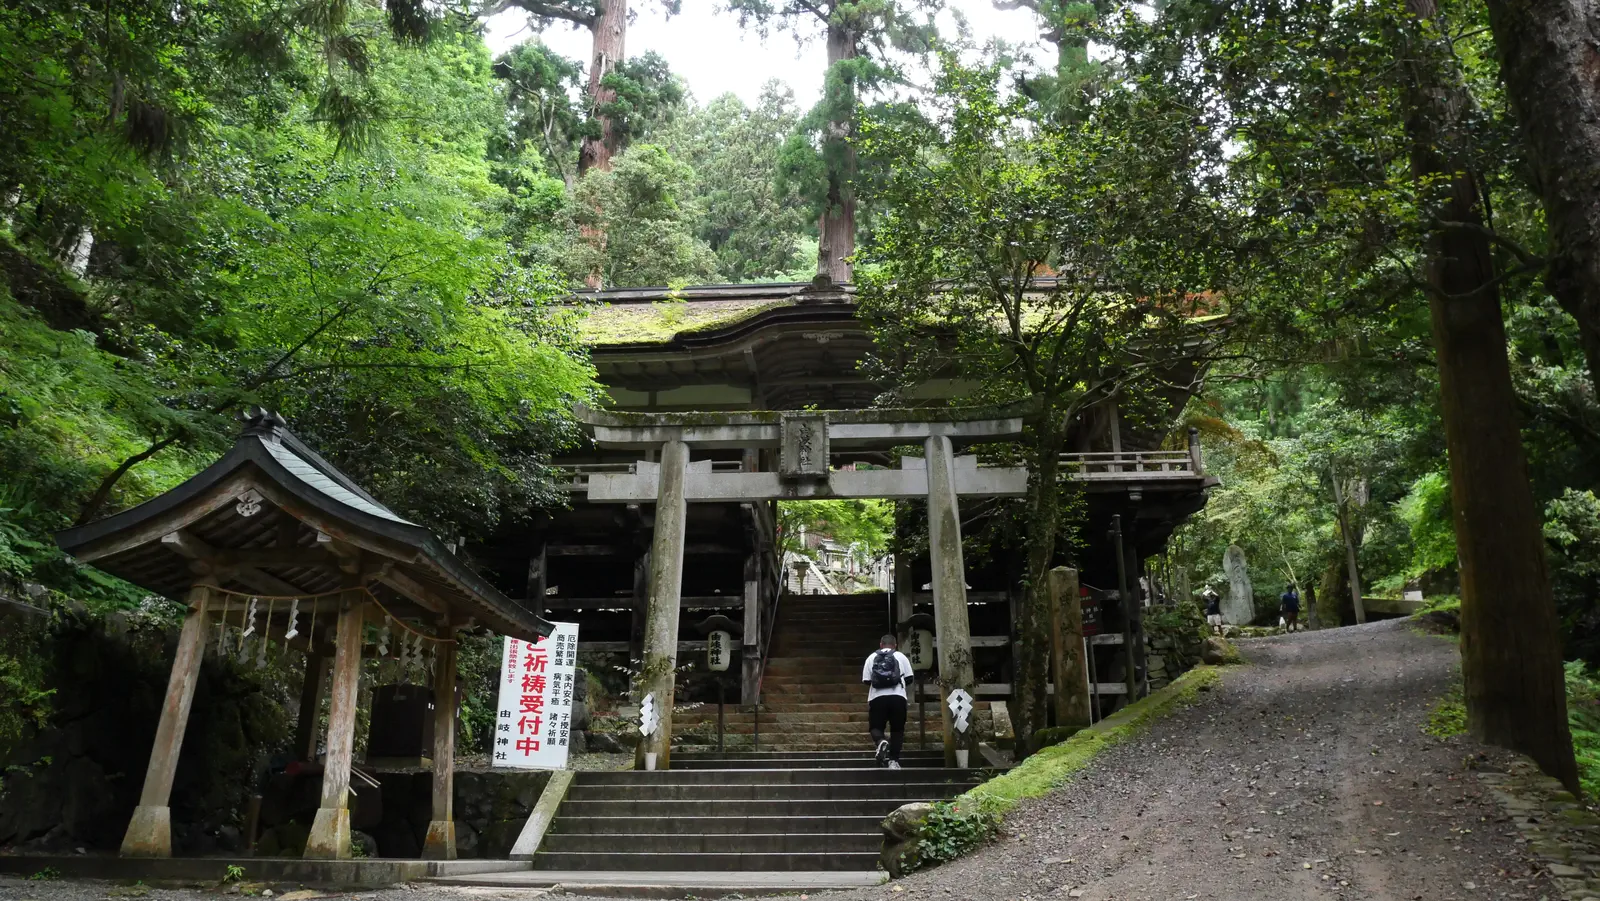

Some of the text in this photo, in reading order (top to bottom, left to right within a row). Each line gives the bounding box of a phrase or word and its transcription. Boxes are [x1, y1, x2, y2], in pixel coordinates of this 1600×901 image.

[554, 634, 565, 666] 商売繁盛
[710, 632, 721, 665] 由岐神社
[559, 634, 576, 746] 厄除開運 家内安全 子授安産
[495, 710, 511, 760] 由岐神社
[547, 712, 558, 746] 諸々祈願
